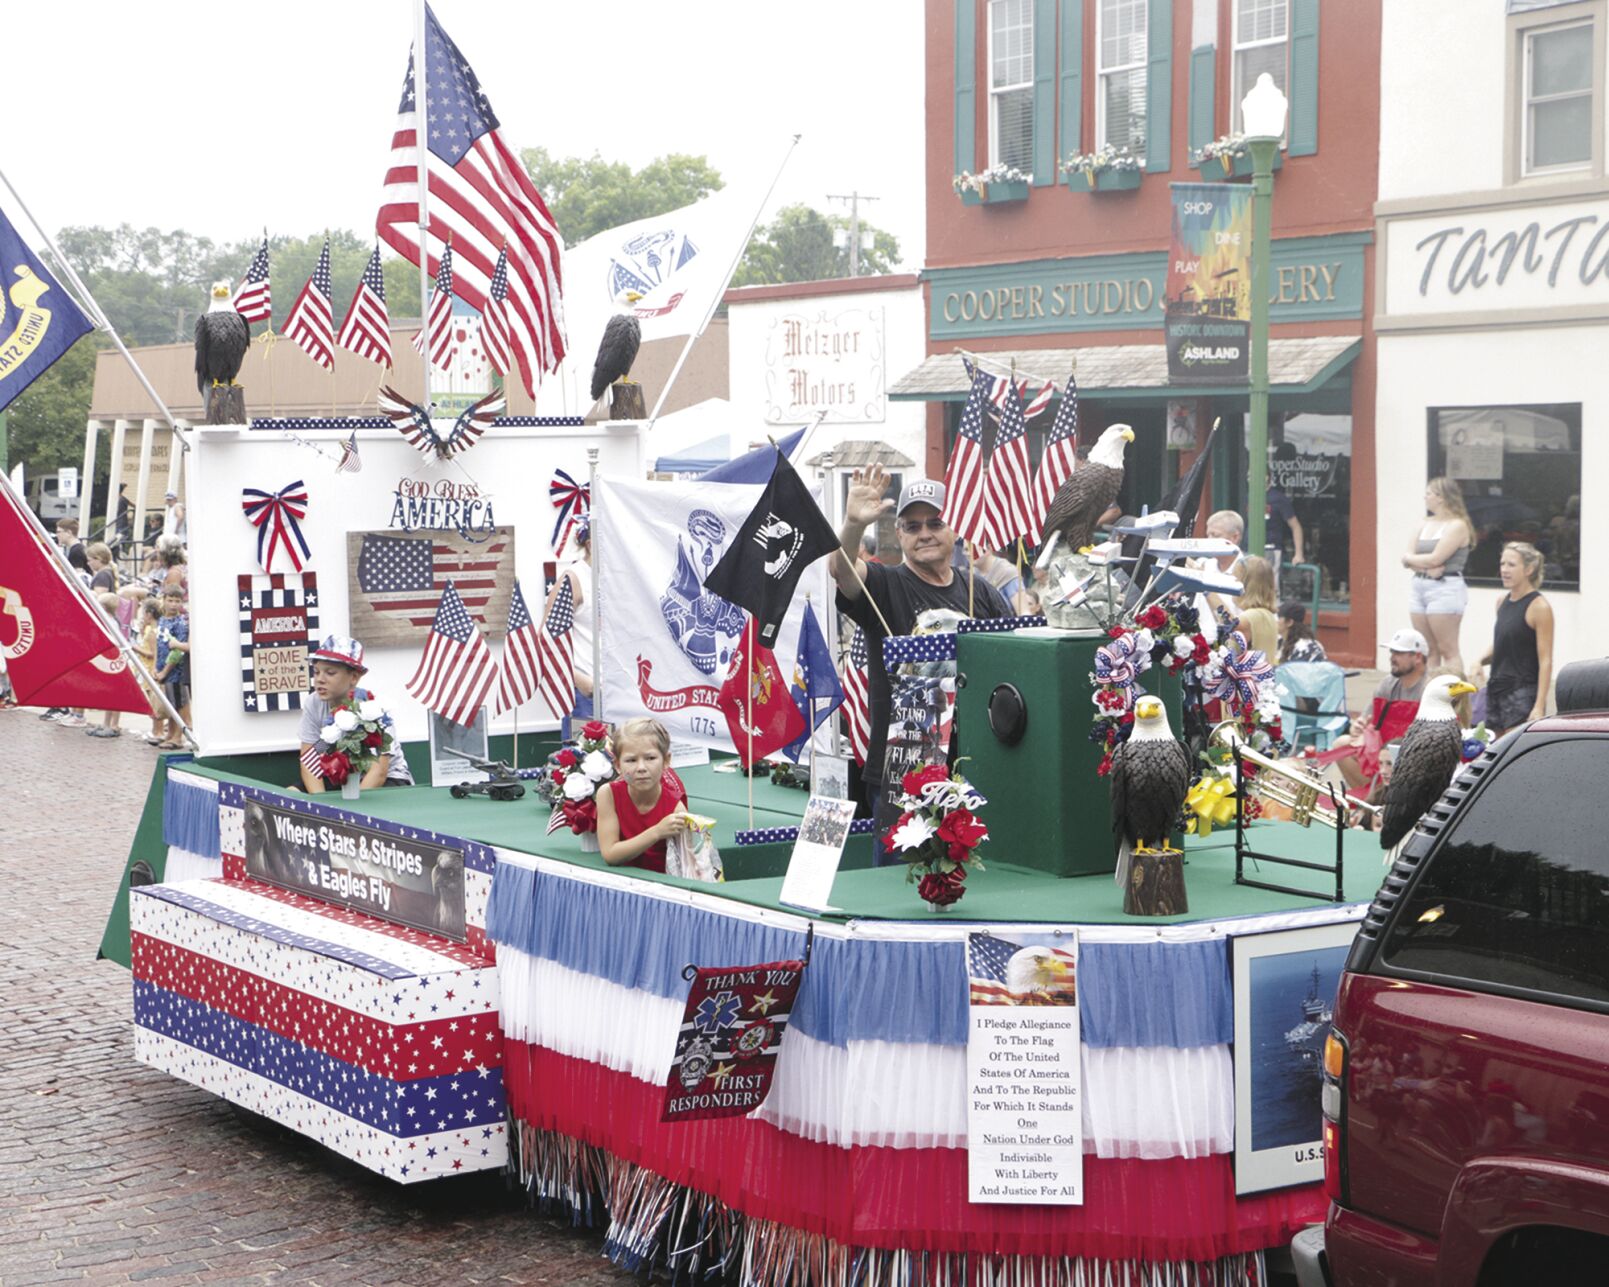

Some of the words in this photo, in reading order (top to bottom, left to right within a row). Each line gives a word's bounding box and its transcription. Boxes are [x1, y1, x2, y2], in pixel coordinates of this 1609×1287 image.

[1183, 202, 1213, 215] SHOP
[1215, 232, 1241, 245] DINE
[1175, 261, 1200, 274] PLAY
[943, 284, 1045, 323] COOPER
[1051, 277, 1153, 316] STUDIO
[1268, 262, 1344, 305] ERY
[782, 319, 860, 363] Metzger
[1184, 346, 1240, 360] ASHLAND
[788, 368, 856, 407] Motors
[1268, 459, 1295, 475] oper
[1295, 455, 1330, 471] Studio
[1280, 471, 1320, 492] Gallery
[388, 490, 497, 543] AMERICA
[254, 615, 306, 634] AMERICA
[257, 649, 300, 665] HOME
[268, 666, 279, 676] of
[280, 665, 297, 675] the
[259, 675, 307, 691] BRAVE
[647, 691, 687, 711] UNITED
[692, 688, 722, 709] STAT
[896, 707, 927, 723] STAND
[690, 716, 716, 737] 1775
[908, 730, 922, 742] THE
[892, 746, 922, 766] FLAG
[921, 778, 988, 811] Hero
[273, 814, 317, 848] Where
[319, 826, 355, 857] Stars
[358, 835, 370, 860] &
[371, 838, 423, 876] Stripes
[308, 860, 318, 885] &
[321, 864, 368, 898] Eagles
[370, 877, 391, 912] Fly
[705, 970, 760, 991] THANK
[764, 970, 798, 987] YOU
[977, 1019, 982, 1028] I
[984, 1019, 1017, 1030] Pledge
[1020, 1019, 1071, 1030] Allegiance
[994, 1035, 1007, 1045] To
[1009, 1035, 1029, 1045] The
[1032, 1035, 1054, 1047] Flag
[989, 1051, 1002, 1062] Of
[1003, 1052, 1023, 1062] The
[1026, 1052, 1060, 1062] United
[980, 1068, 1011, 1078] States
[1013, 1068, 1027, 1078] Of
[1028, 1069, 1070, 1079] America
[720, 1074, 765, 1090] FIRST
[973, 1085, 993, 1095] And
[995, 1085, 1009, 1095] To
[1010, 1085, 1030, 1095] The
[1033, 1085, 1076, 1096] Republic
[669, 1091, 762, 1114] RESPONDERS
[974, 1101, 991, 1111] For
[993, 1101, 1025, 1111] Which
[1027, 1101, 1036, 1111] It
[1038, 1102, 1074, 1112] Stands
[1017, 1118, 1038, 1128] One
[983, 1134, 1017, 1144] Nation
[1020, 1134, 1051, 1144] Under
[1053, 1135, 1074, 1145] God
[1000, 1152, 1053, 1163] Indivisible
[994, 1169, 1019, 1179] With
[1022, 1169, 1058, 1181] Liberty
[979, 1185, 1000, 1195] And
[1002, 1185, 1037, 1196] Justice
[1040, 1186, 1058, 1196] For
[1060, 1186, 1075, 1196] All
